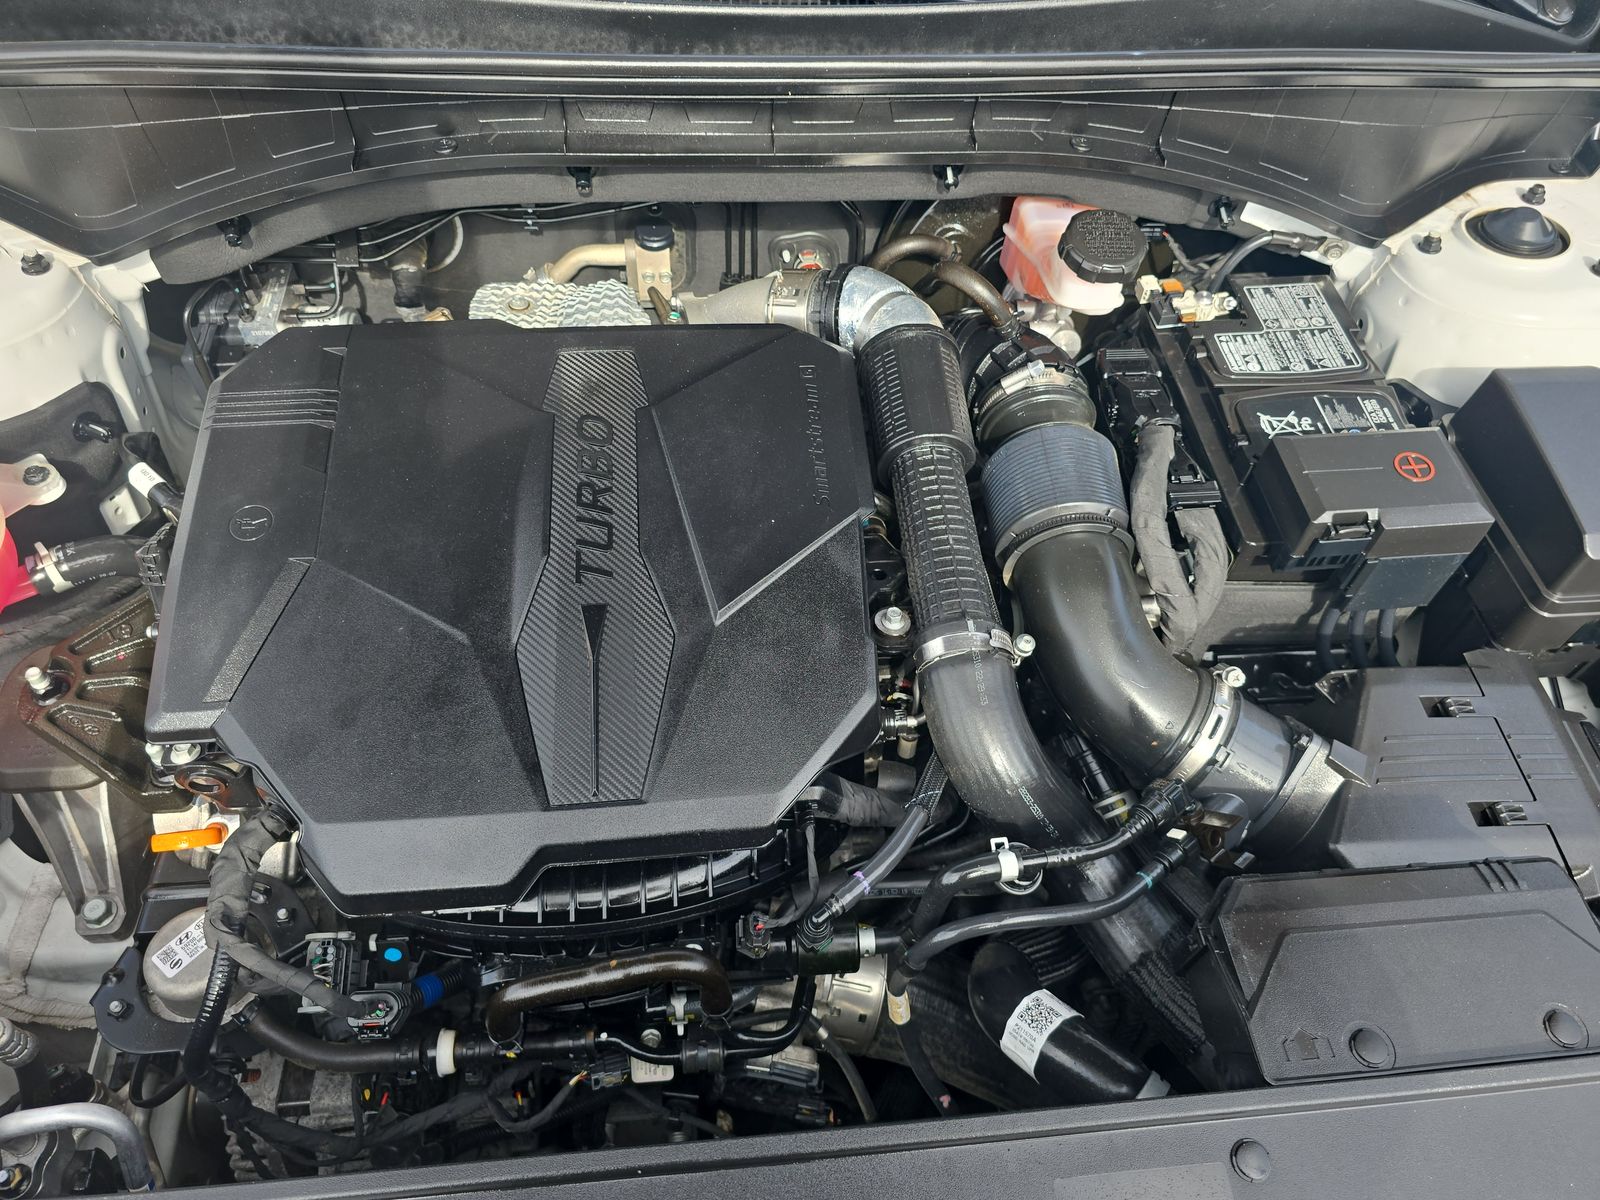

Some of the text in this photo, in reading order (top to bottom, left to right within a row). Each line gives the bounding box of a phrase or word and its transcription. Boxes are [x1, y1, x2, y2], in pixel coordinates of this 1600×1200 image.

[806, 383, 830, 505] Smartstream
[1300, 416, 1315, 431] Pb
[575, 414, 614, 584] TURBO
